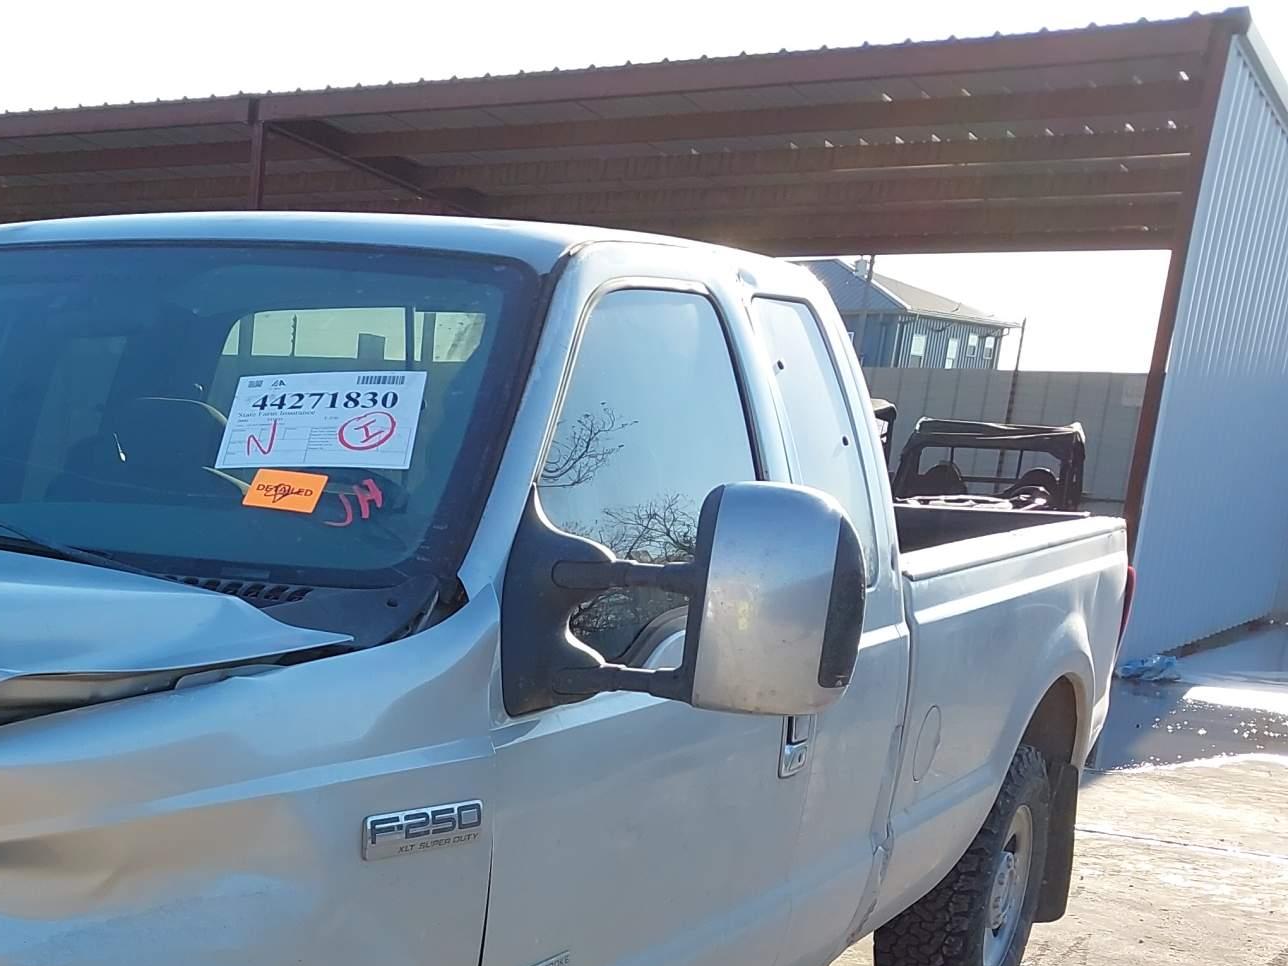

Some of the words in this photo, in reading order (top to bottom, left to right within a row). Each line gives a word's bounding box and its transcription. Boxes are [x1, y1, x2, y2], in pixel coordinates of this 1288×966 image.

[252, 391, 399, 411] 44271830
[418, 838, 451, 850] SUPER
[452, 832, 479, 843] DUTY
